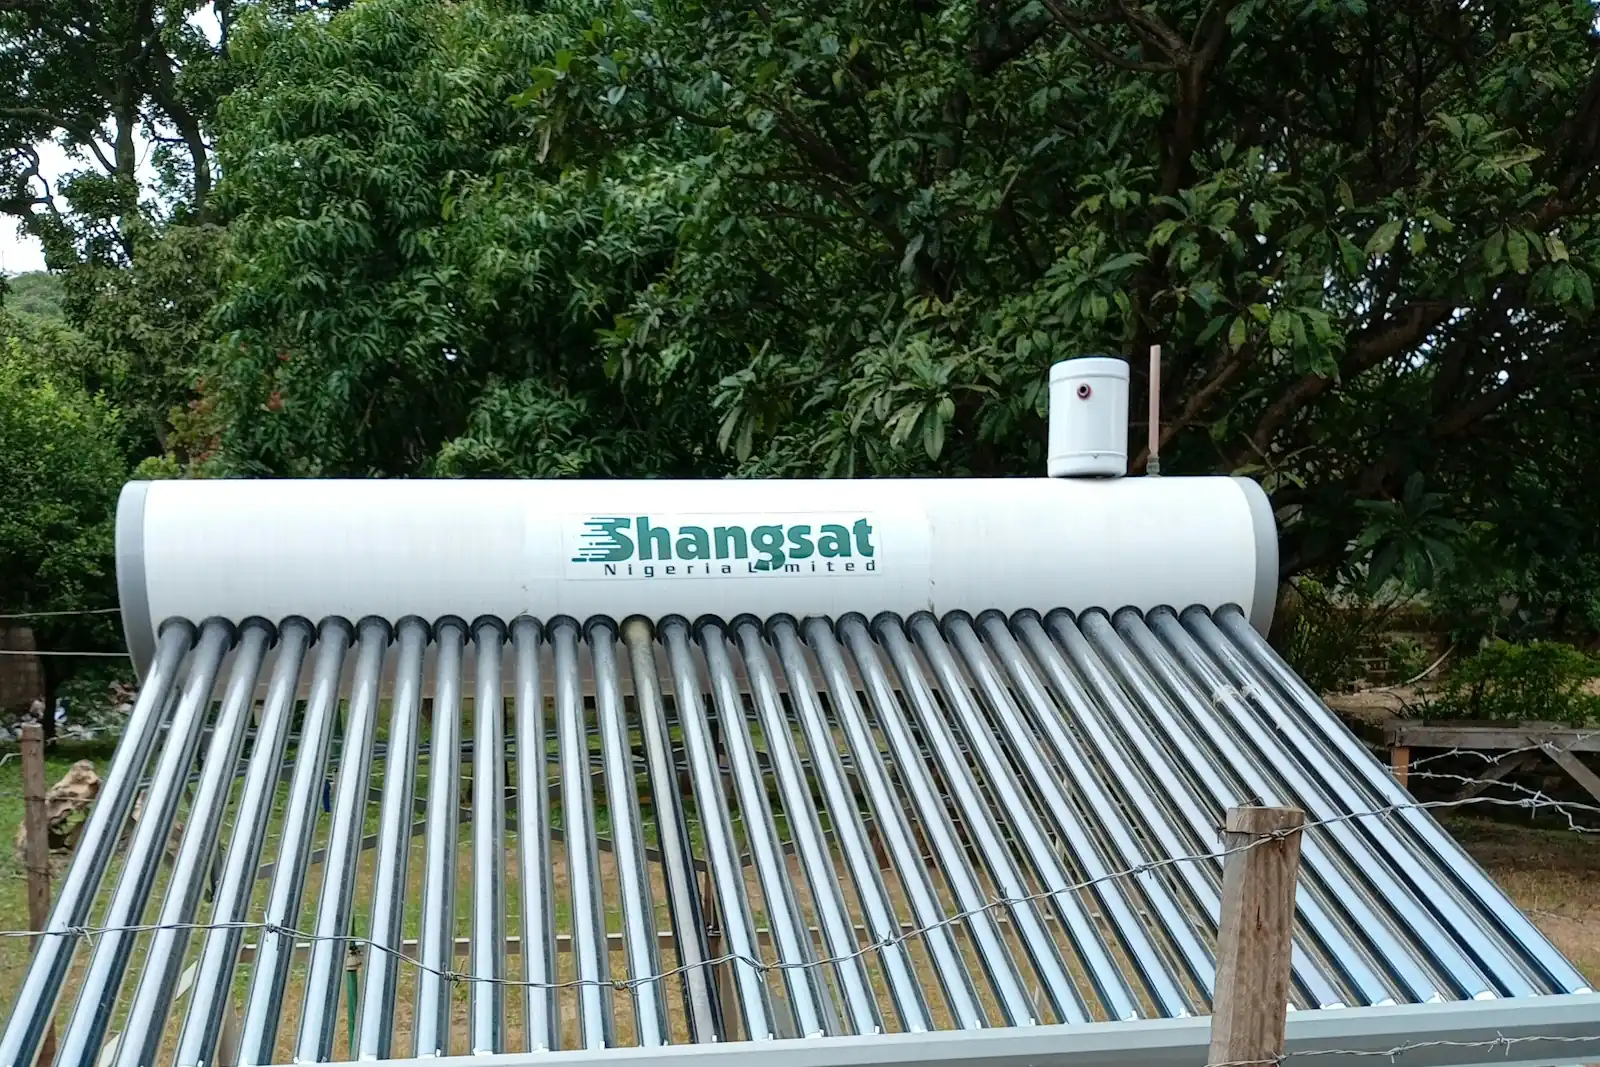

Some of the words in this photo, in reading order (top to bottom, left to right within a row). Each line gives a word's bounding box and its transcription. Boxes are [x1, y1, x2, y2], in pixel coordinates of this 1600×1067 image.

[573, 516, 875, 571] Shangsat
[604, 563, 731, 578] Nigeria
[748, 560, 875, 573] Limited
